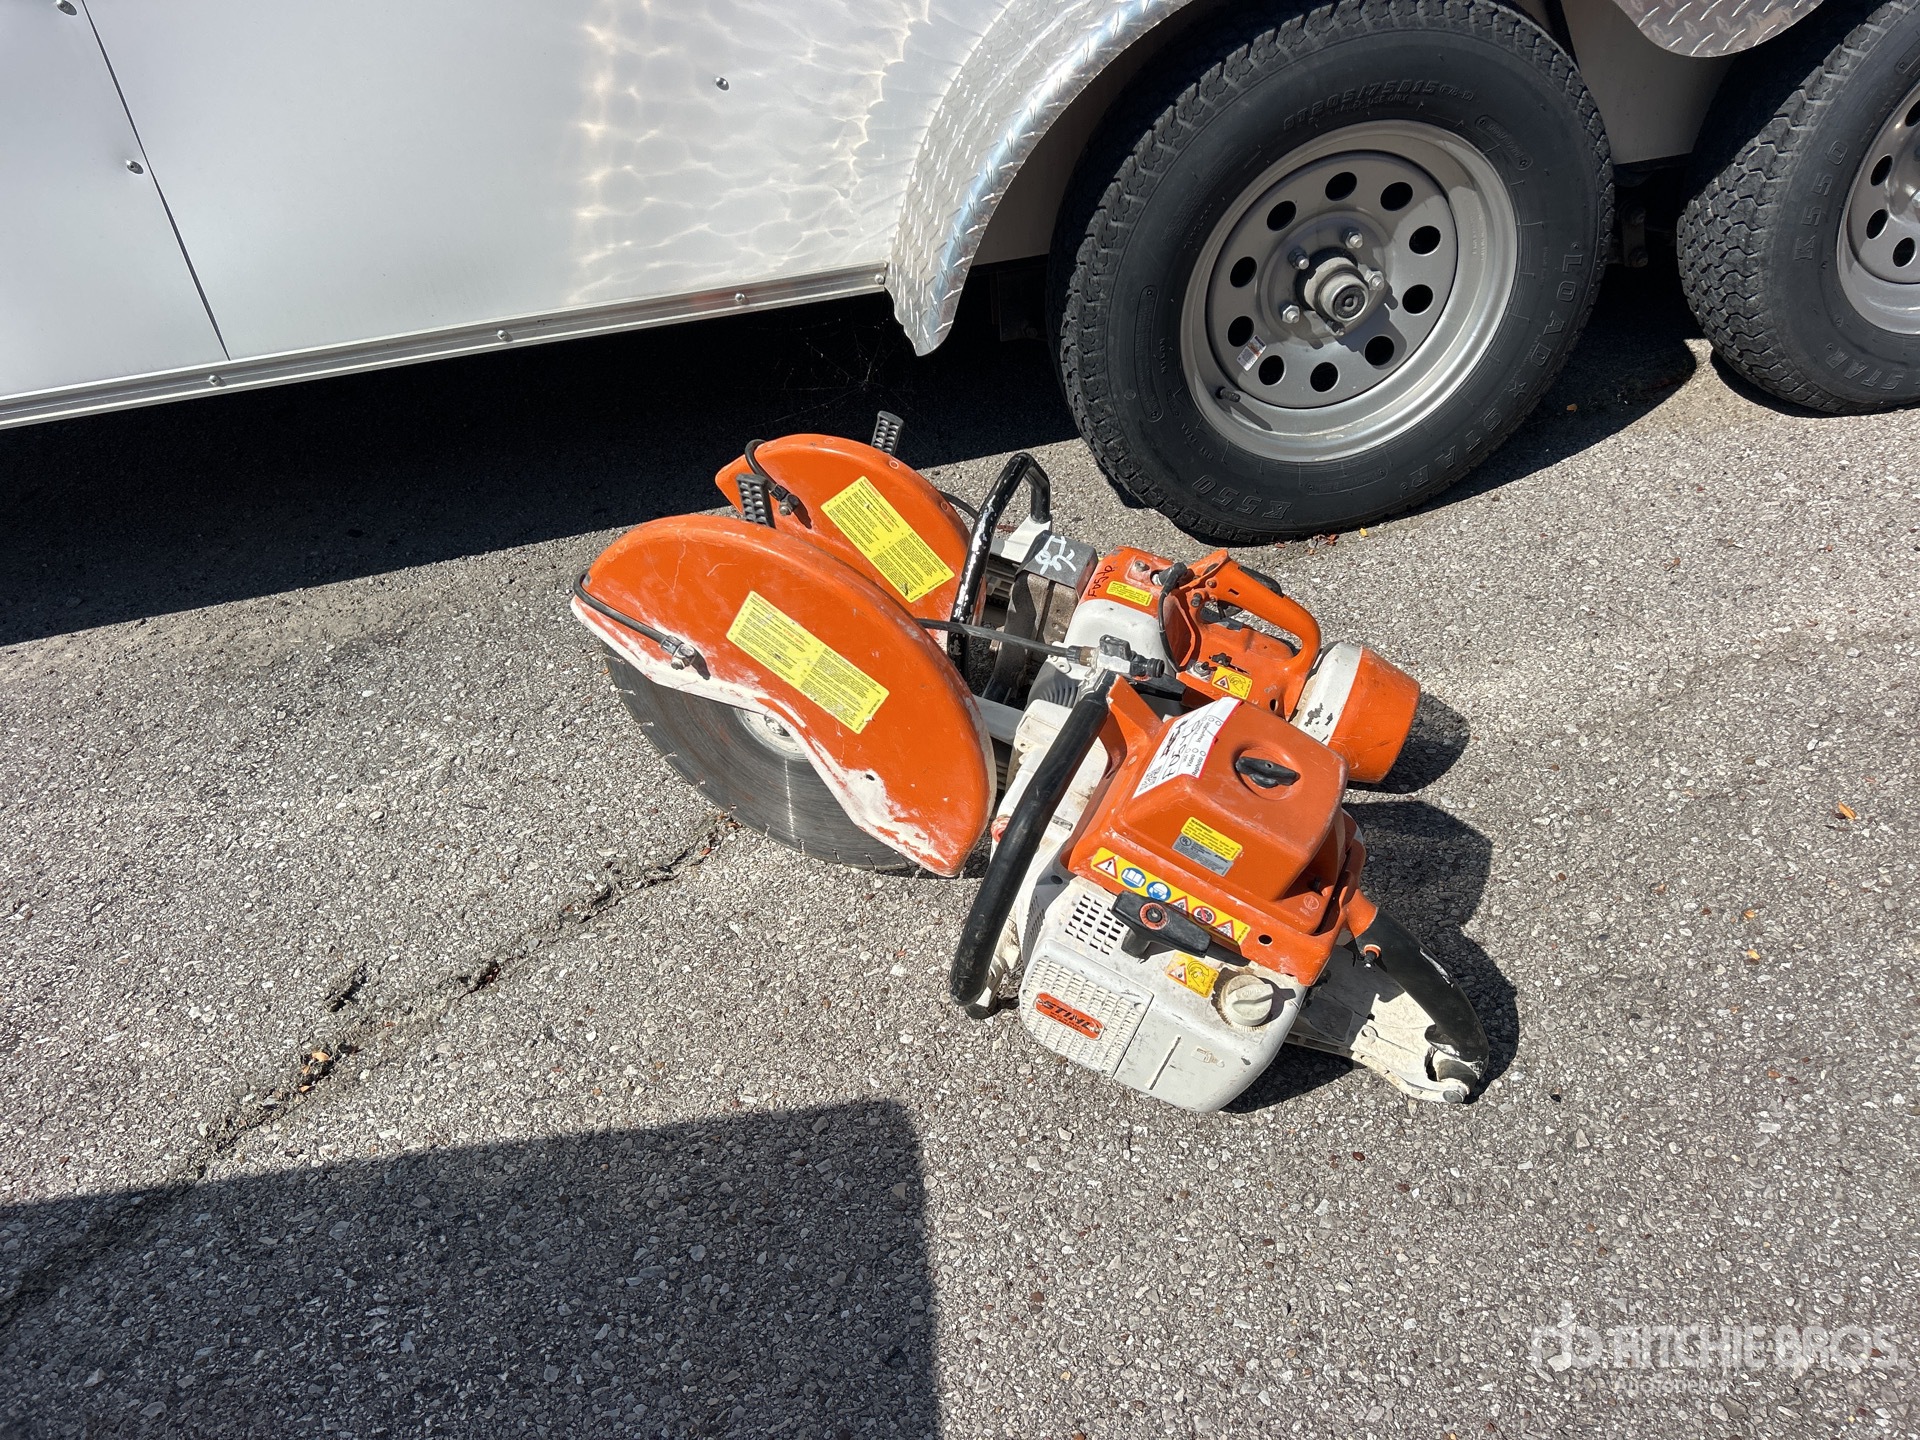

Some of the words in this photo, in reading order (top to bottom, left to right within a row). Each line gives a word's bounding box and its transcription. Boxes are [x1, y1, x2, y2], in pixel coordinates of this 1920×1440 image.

[1794, 140, 1849, 261] K550
[1531, 253, 1583, 367] LOAD
[1825, 347, 1906, 390] STAR
[1409, 407, 1501, 488] STAR
[1192, 474, 1292, 520] K550
[1040, 1000, 1094, 1031] STIHL
